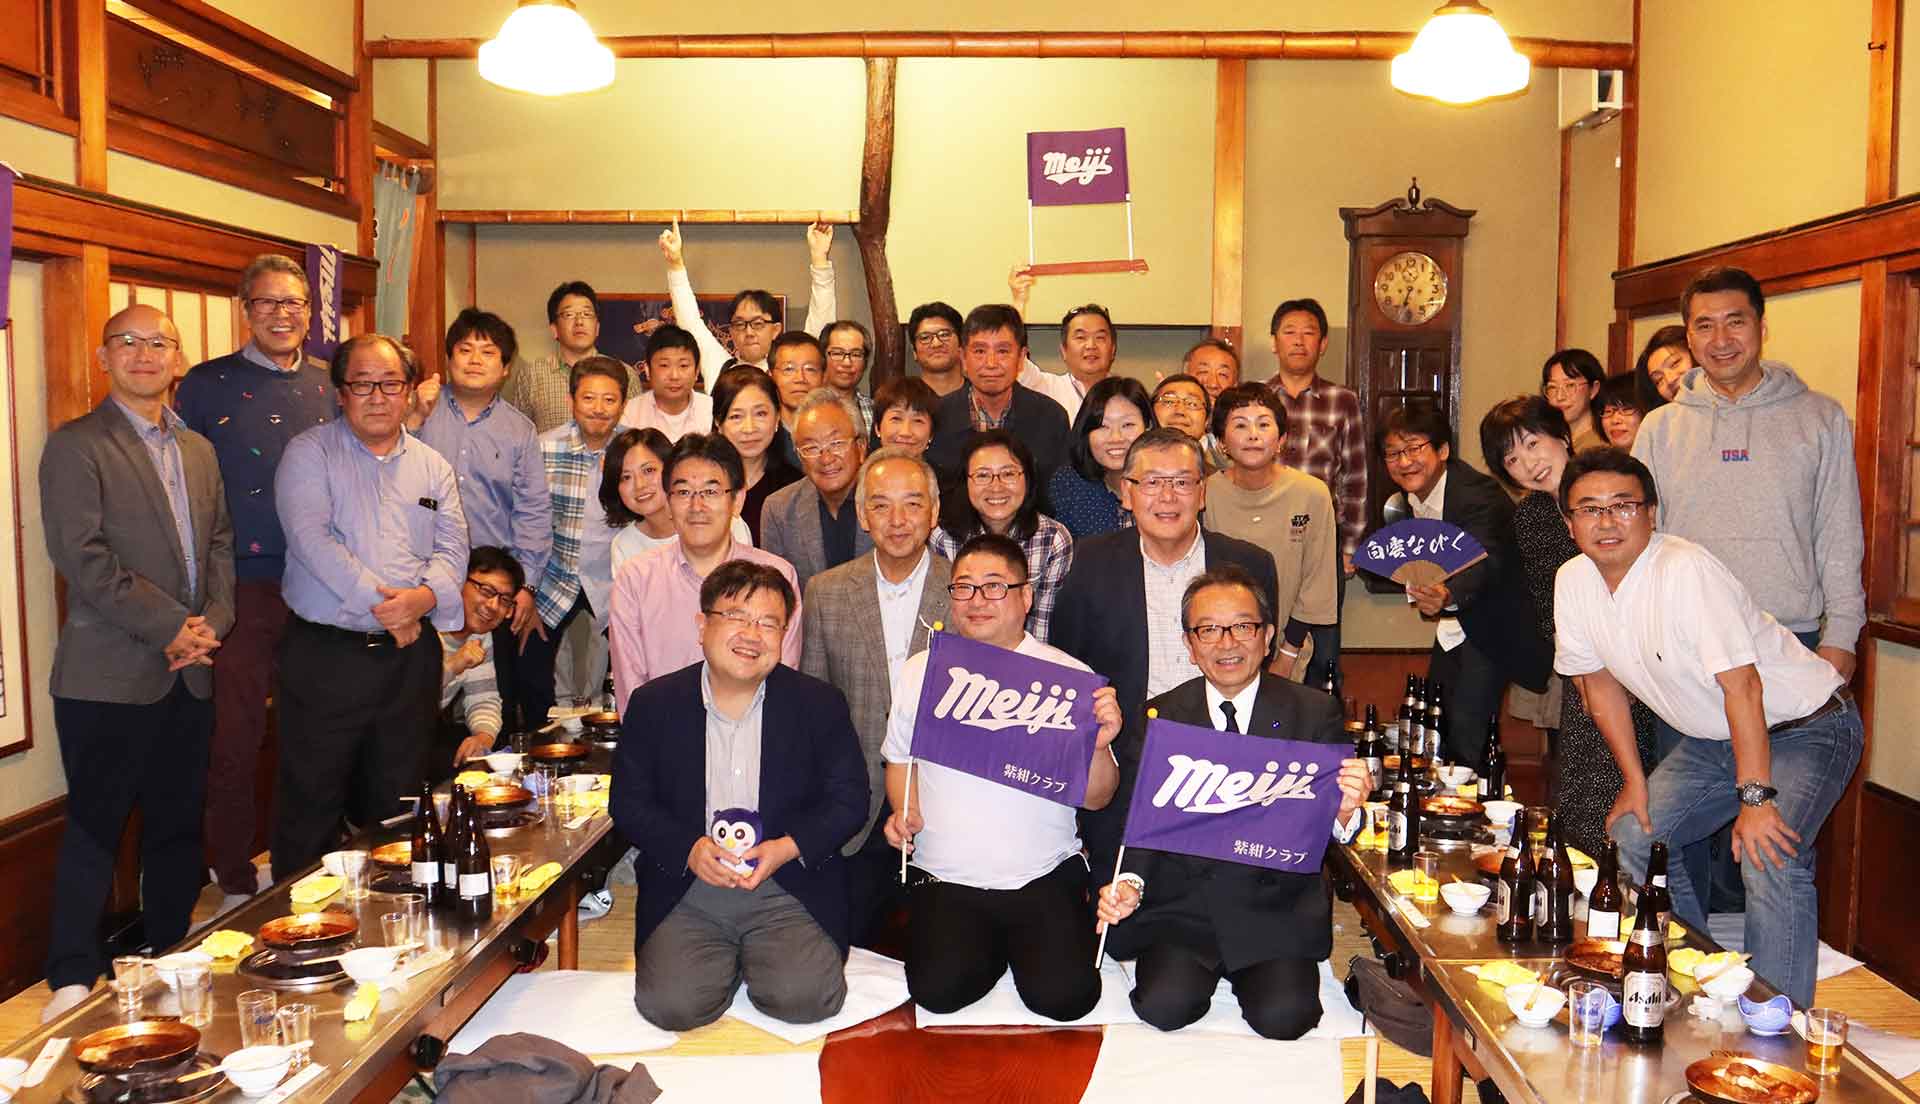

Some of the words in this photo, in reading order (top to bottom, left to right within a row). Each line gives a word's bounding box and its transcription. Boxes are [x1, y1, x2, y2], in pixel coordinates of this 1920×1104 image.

[1721, 449, 1750, 462] USA
[1003, 763, 1067, 793] 紫紺クラブ
[1233, 840, 1308, 865] 紫紺クラブ
